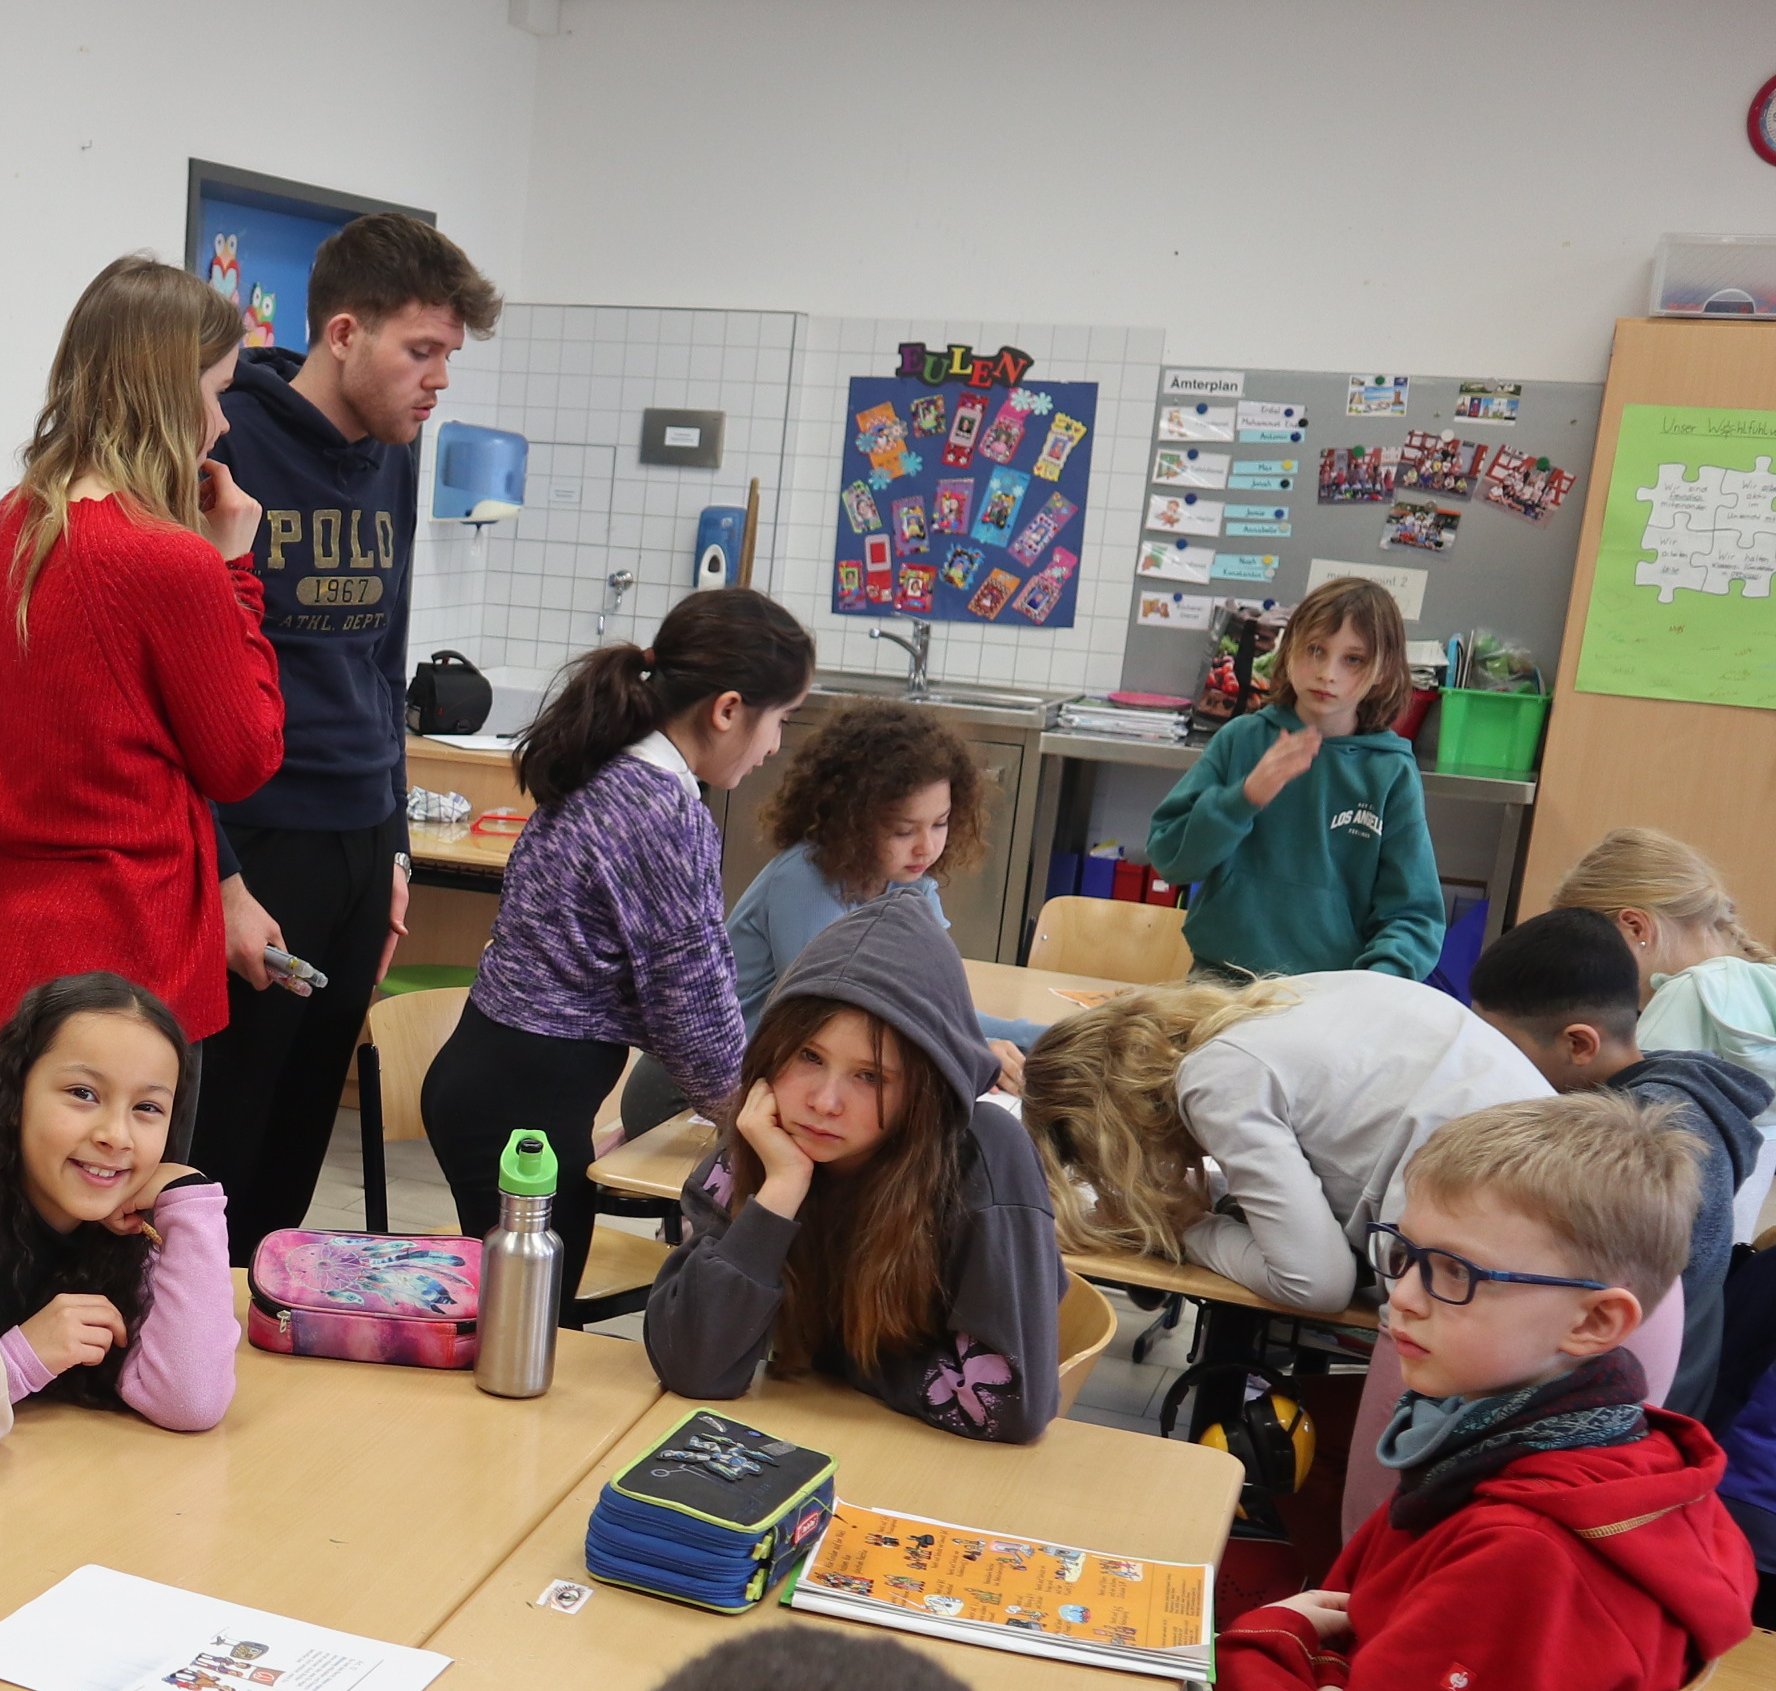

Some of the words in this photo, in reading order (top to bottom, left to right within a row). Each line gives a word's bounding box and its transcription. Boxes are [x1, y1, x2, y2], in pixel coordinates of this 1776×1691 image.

[906, 344, 1027, 388] EULEN
[1170, 375, 1238, 393] Ämterplan
[1662, 415, 1696, 435] Unser
[268, 509, 395, 569] POLO
[313, 578, 369, 604] 1967
[279, 613, 334, 632] ATHL.
[341, 611, 388, 632] DEPT.
[1330, 810, 1354, 830] LOS
[1352, 809, 1383, 836] ANGEL
